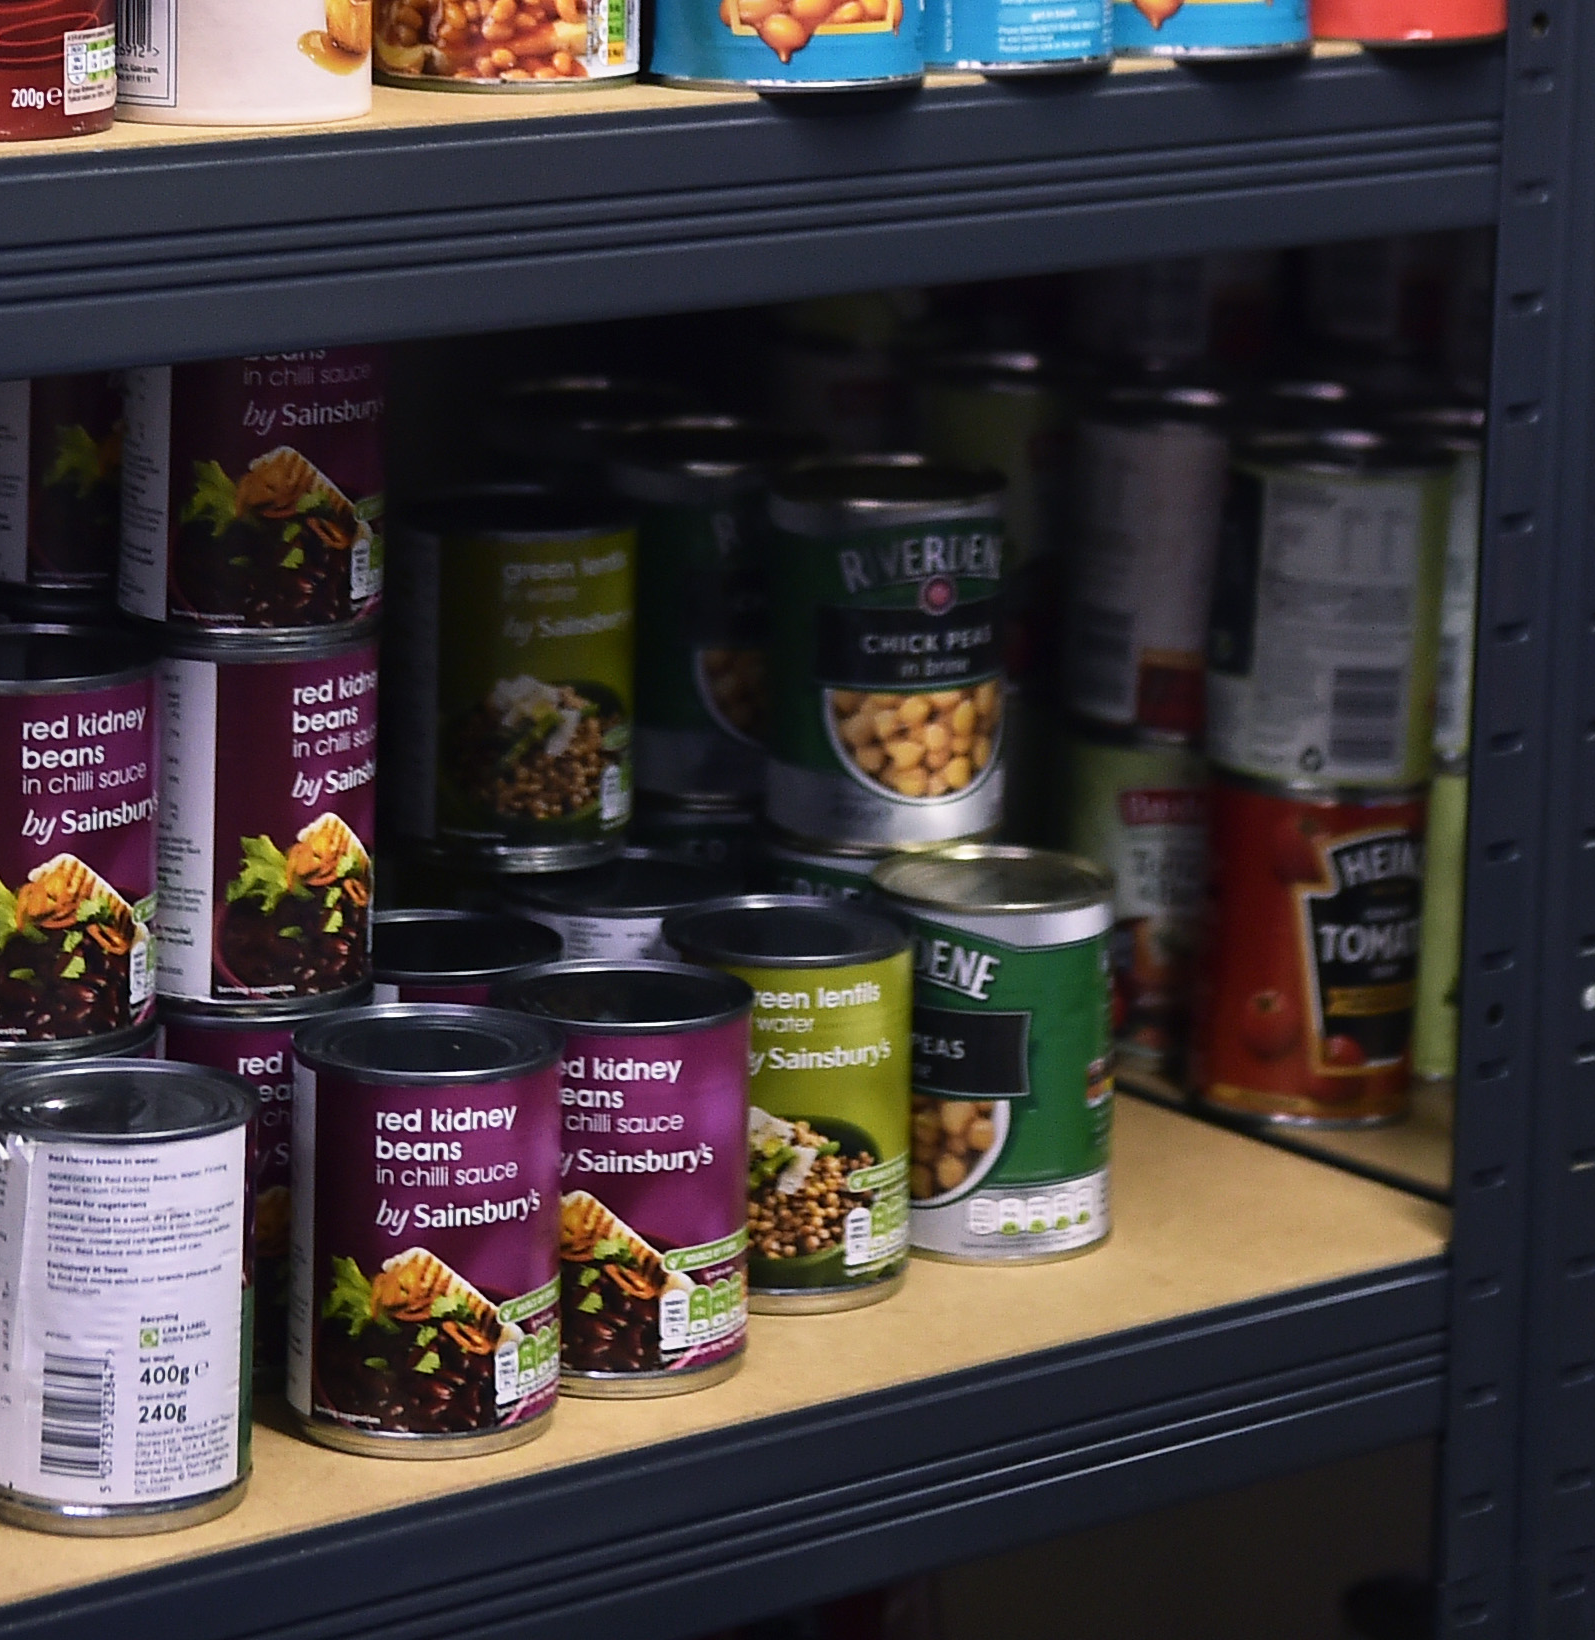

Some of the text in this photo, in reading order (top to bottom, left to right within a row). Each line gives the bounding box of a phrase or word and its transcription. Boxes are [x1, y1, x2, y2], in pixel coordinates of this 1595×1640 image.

[243, 399, 277, 437] by
[292, 678, 334, 706] red
[22, 705, 147, 741] red kidney
[292, 705, 360, 734] beans
[22, 744, 106, 770] beans
[292, 738, 311, 758] in
[22, 761, 148, 795] in chilli sauce
[21, 808, 57, 846] by
[756, 1015, 816, 1034] water
[237, 1050, 284, 1076] red
[592, 1056, 684, 1085] kidney
[375, 1105, 518, 1134] red kidney
[615, 1113, 685, 1134] sauce
[96, 1157, 122, 1165] beans
[375, 1134, 463, 1162] beans
[576, 1141, 714, 1174] Sainsbury's
[375, 1161, 519, 1188] in chilli sauce
[375, 1187, 542, 1238] by Sainsbury's
[139, 1363, 190, 1386] 400g
[138, 1402, 188, 1425] 240g
